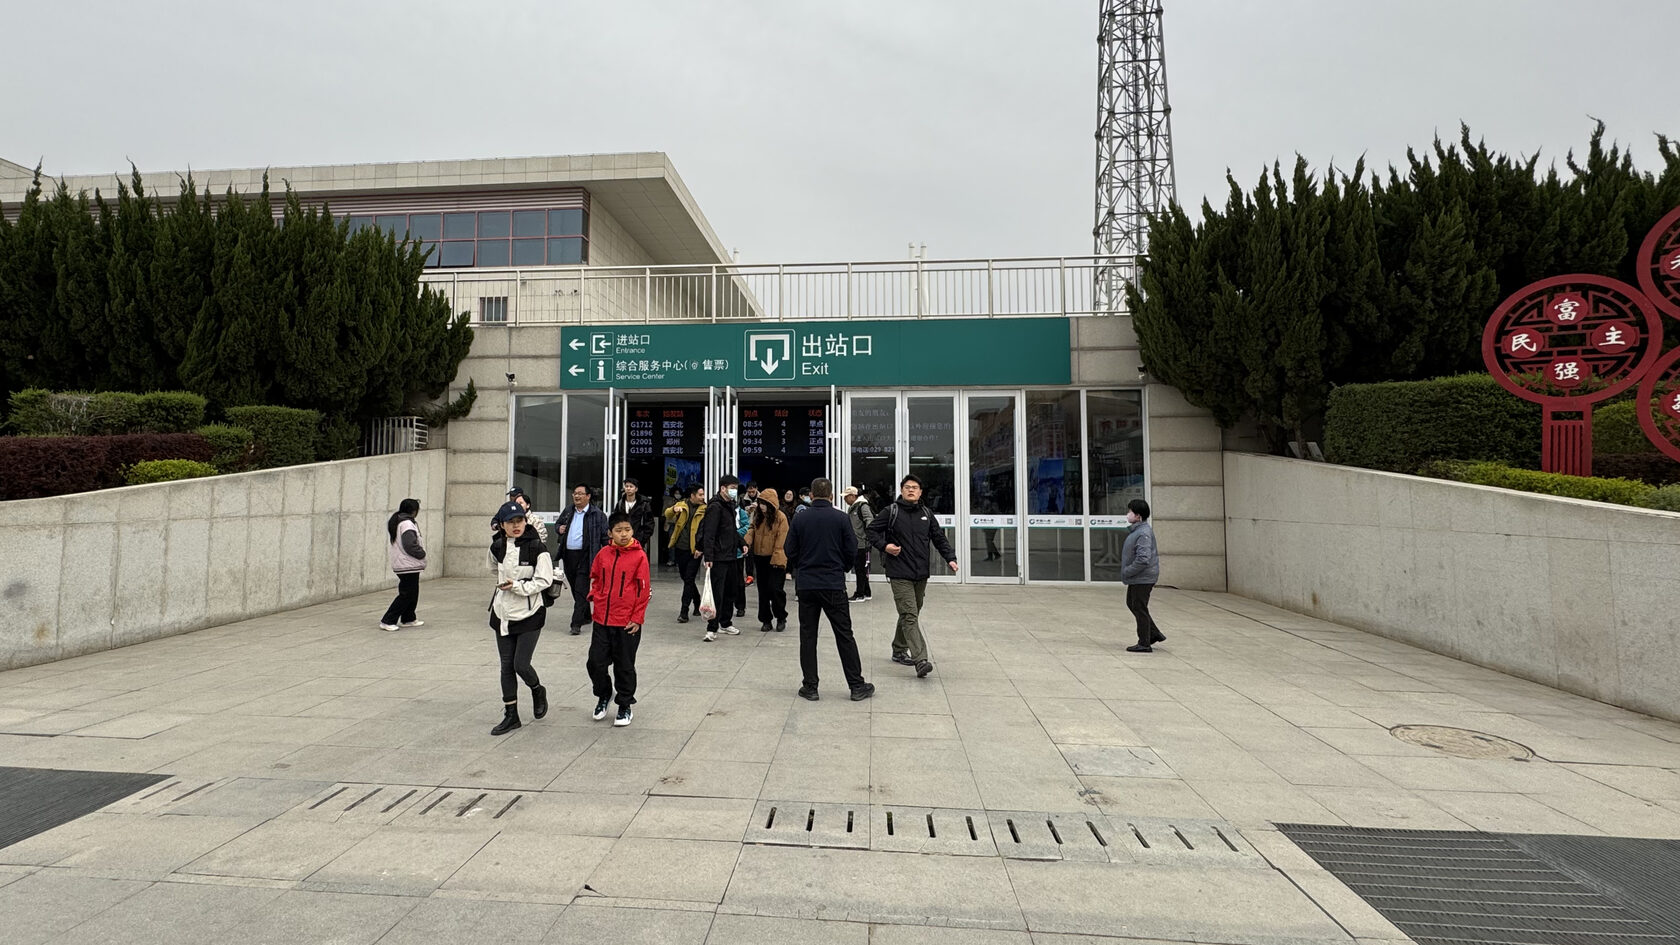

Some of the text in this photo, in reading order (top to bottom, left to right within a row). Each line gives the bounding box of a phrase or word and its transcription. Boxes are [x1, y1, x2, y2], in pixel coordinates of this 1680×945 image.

[616, 334, 650, 346] 进站口
[802, 333, 872, 357] 出站口
[802, 362, 829, 375] Exit
[630, 429, 653, 437] G1896
[742, 446, 762, 454] 09:59
[781, 446, 786, 454] 4
[809, 446, 824, 454] 正点
